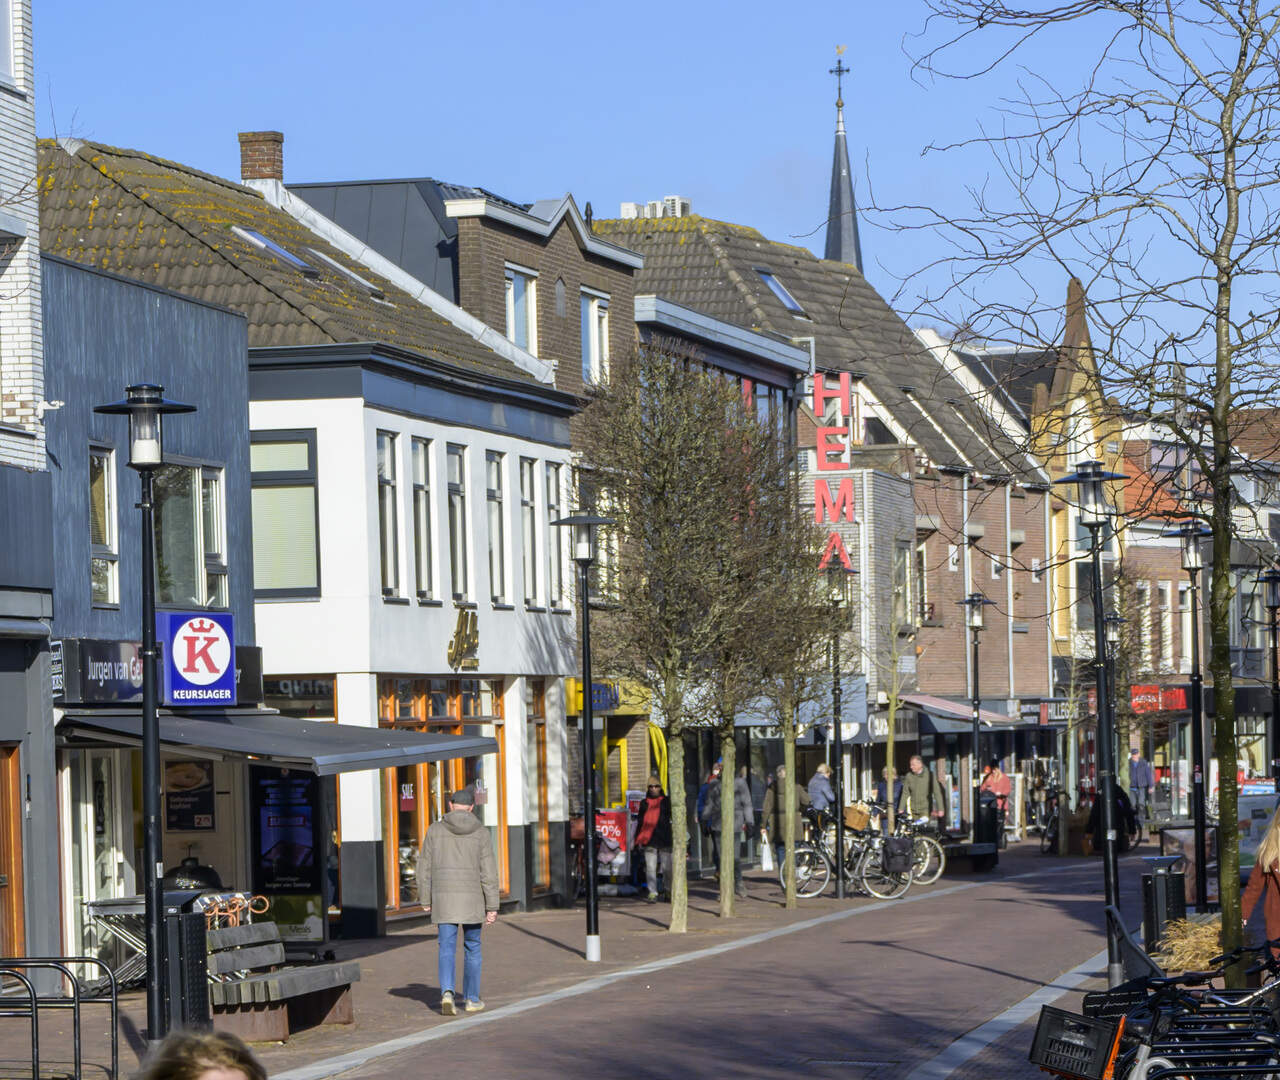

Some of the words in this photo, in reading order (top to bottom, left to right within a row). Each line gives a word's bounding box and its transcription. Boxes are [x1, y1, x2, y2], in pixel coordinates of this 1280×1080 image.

[813, 372, 855, 575] HEMA
[182, 635, 221, 674] K
[87, 655, 113, 687] Jurgen
[113, 662, 129, 681] van
[173, 689, 232, 700] KEURSLAGER
[401, 783, 414, 800] SALE
